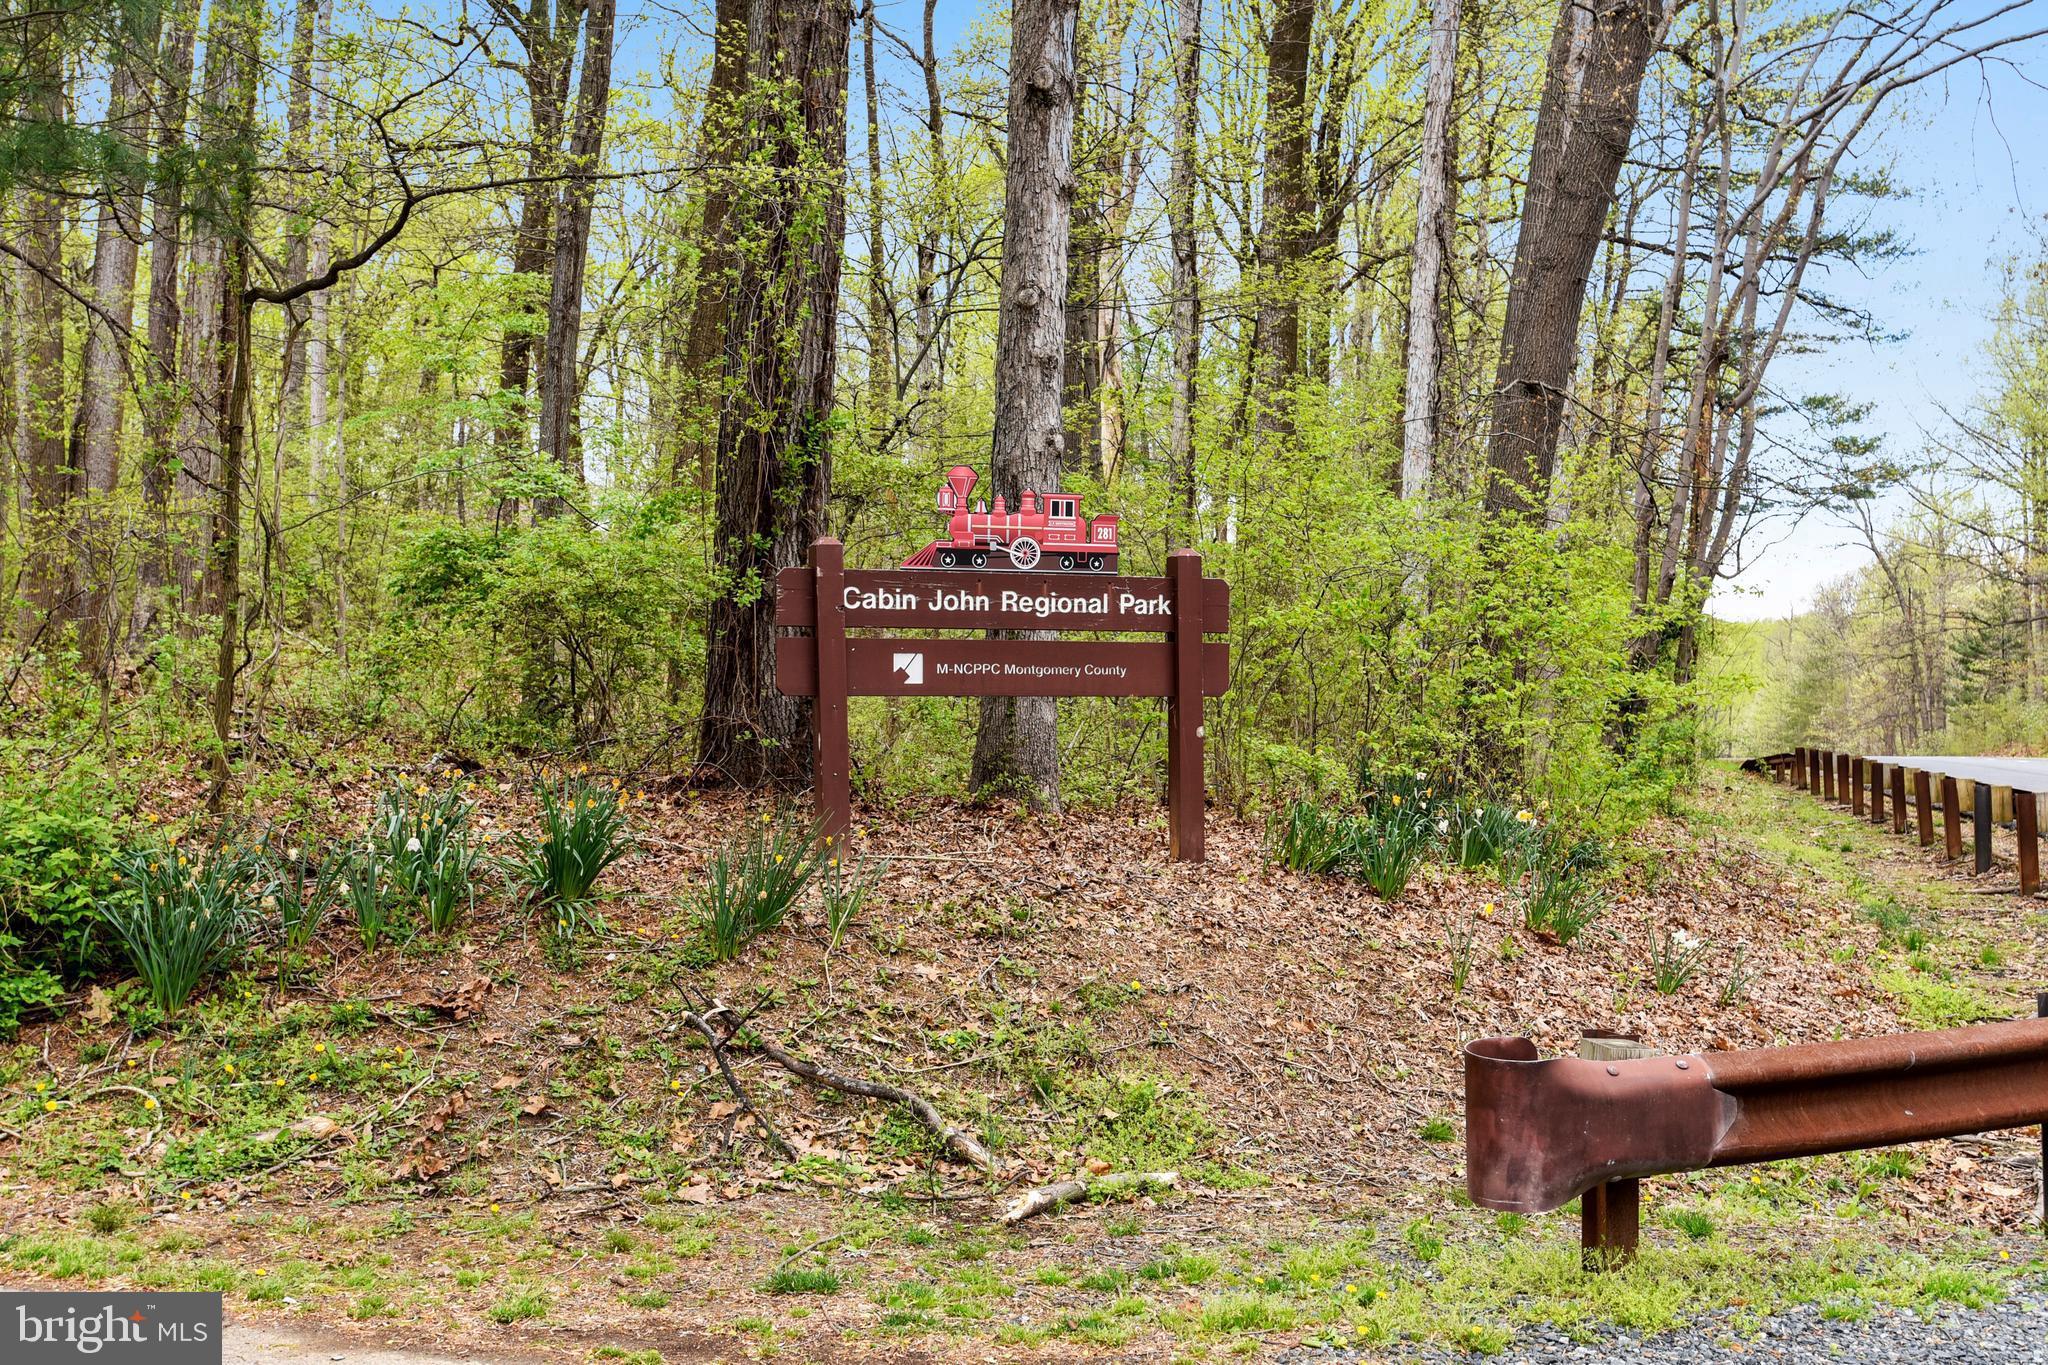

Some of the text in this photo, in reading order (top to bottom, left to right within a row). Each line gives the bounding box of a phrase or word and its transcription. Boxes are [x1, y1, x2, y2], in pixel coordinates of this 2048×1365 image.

[1097, 527, 1113, 540] 281
[843, 586, 1172, 618] Cabin John Regional Park
[936, 663, 1127, 678] M-NCPPC Montgomery County
